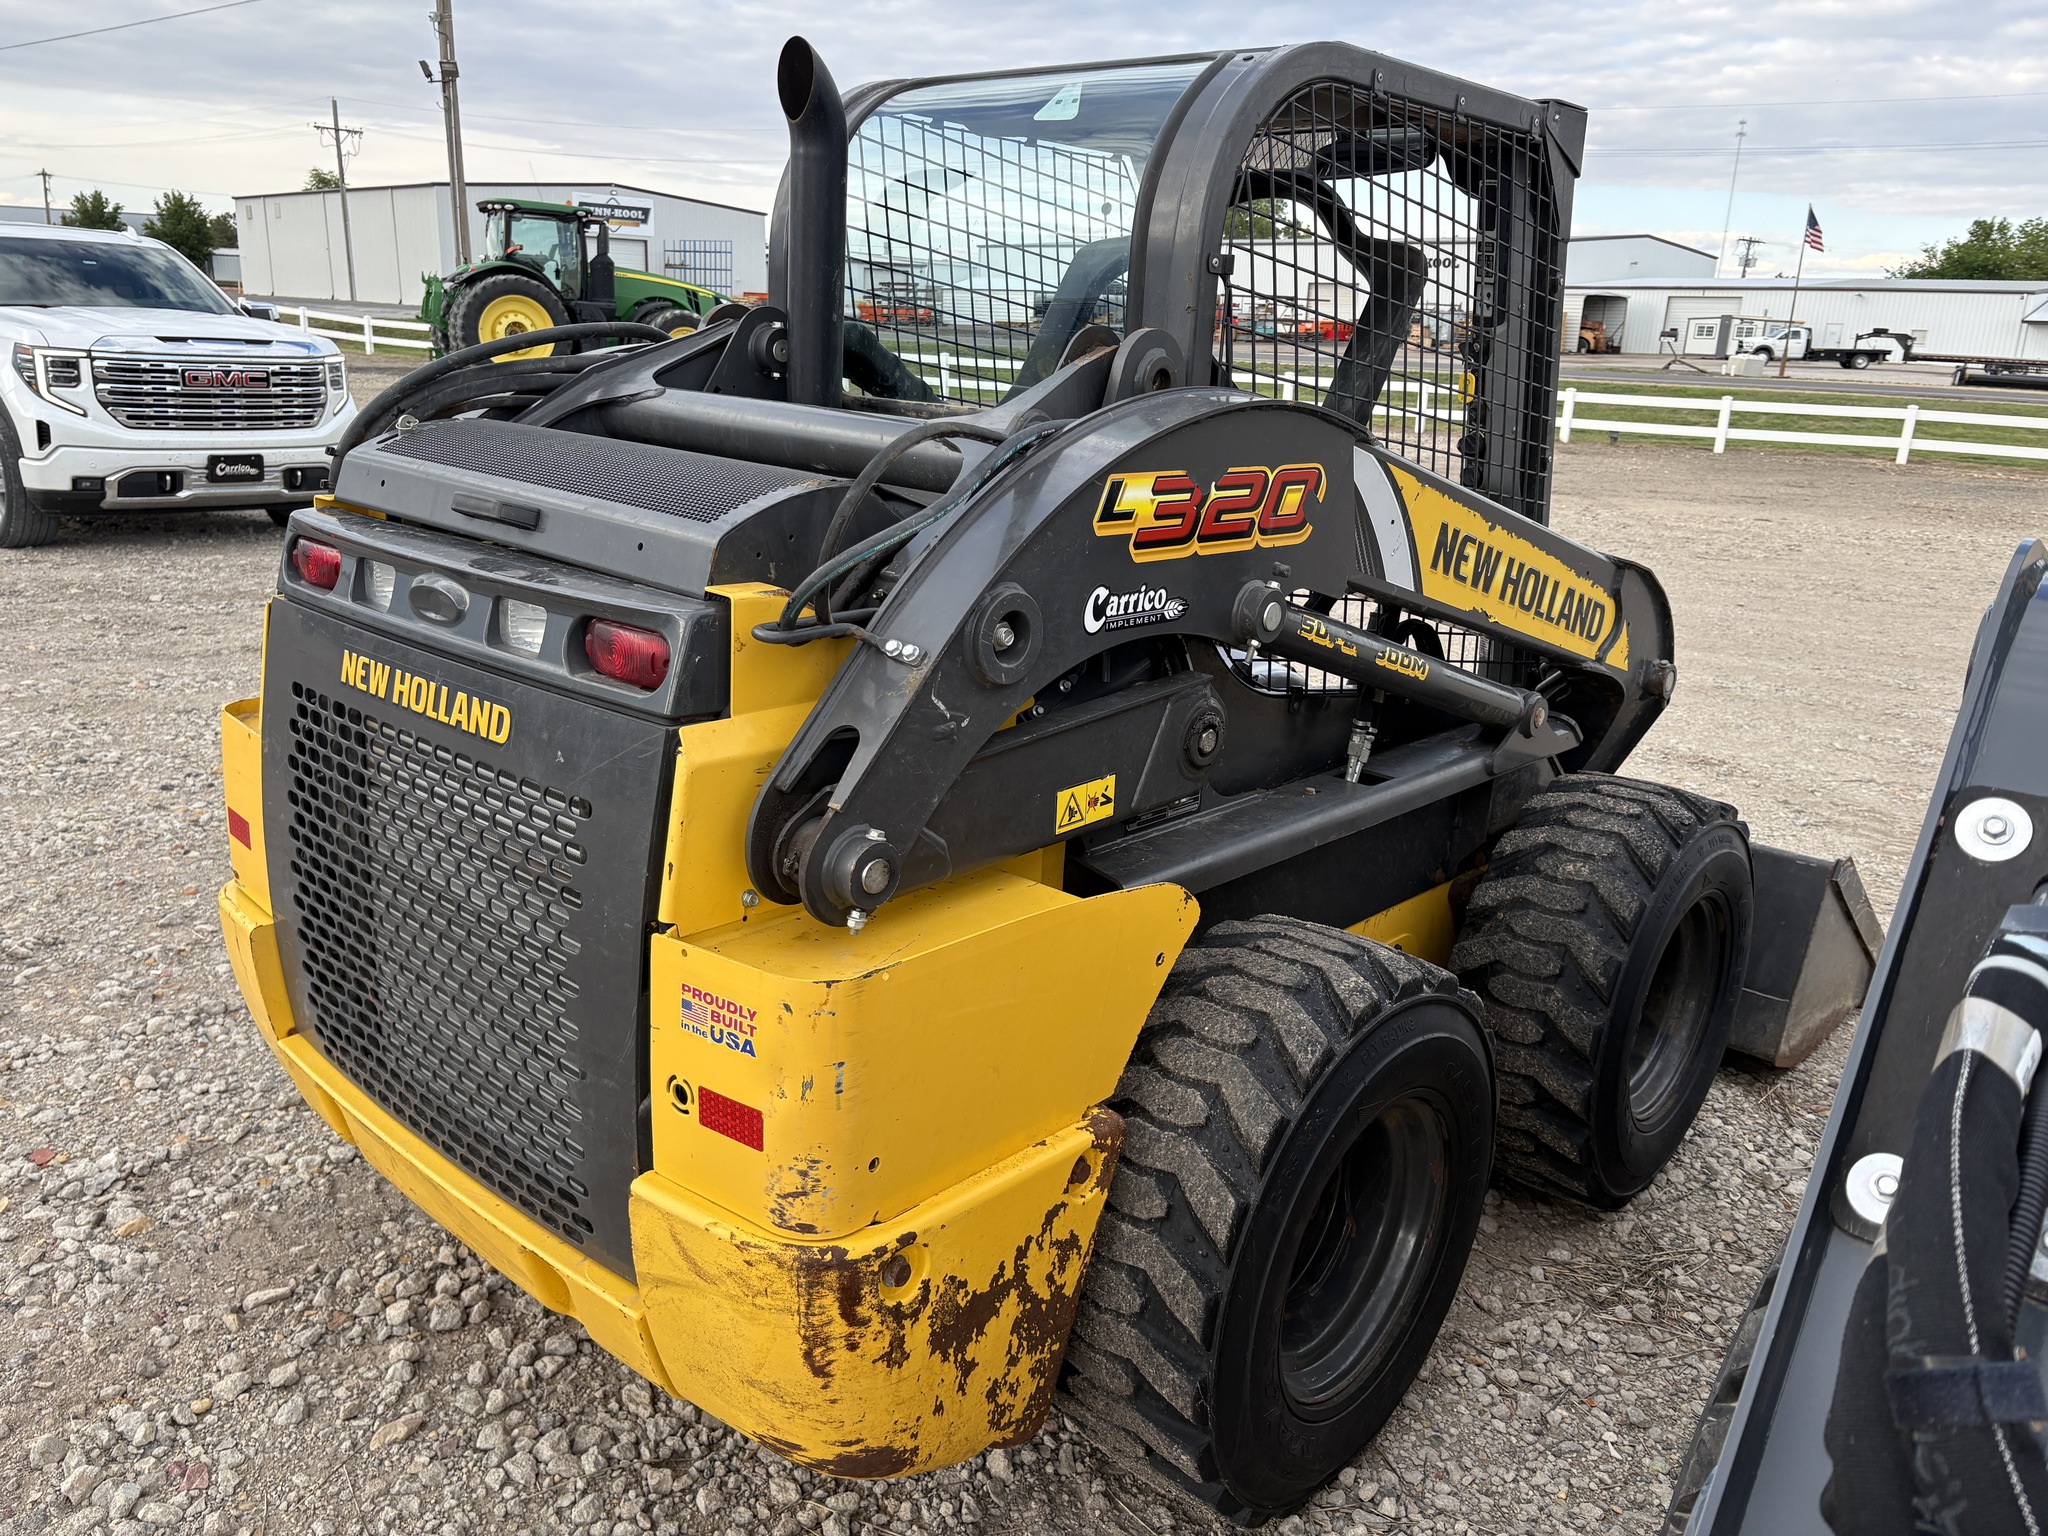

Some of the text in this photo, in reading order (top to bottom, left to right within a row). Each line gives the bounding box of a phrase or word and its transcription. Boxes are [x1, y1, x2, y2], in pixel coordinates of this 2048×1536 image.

[185, 371, 267, 387] GMC
[216, 463, 251, 476] Carrico
[1094, 464, 1327, 562] L320
[1429, 520, 1606, 643] NEW HOLLAND
[1084, 584, 1167, 633] Carrico
[1106, 614, 1162, 630] IMPLEMENT
[340, 649, 511, 745] NEW HOLLAND
[681, 983, 757, 1022] PROUDLY
[681, 1020, 757, 1058] in the USA
[710, 1008, 757, 1038] BUILT
[1382, 1019, 1415, 1047] RATING
